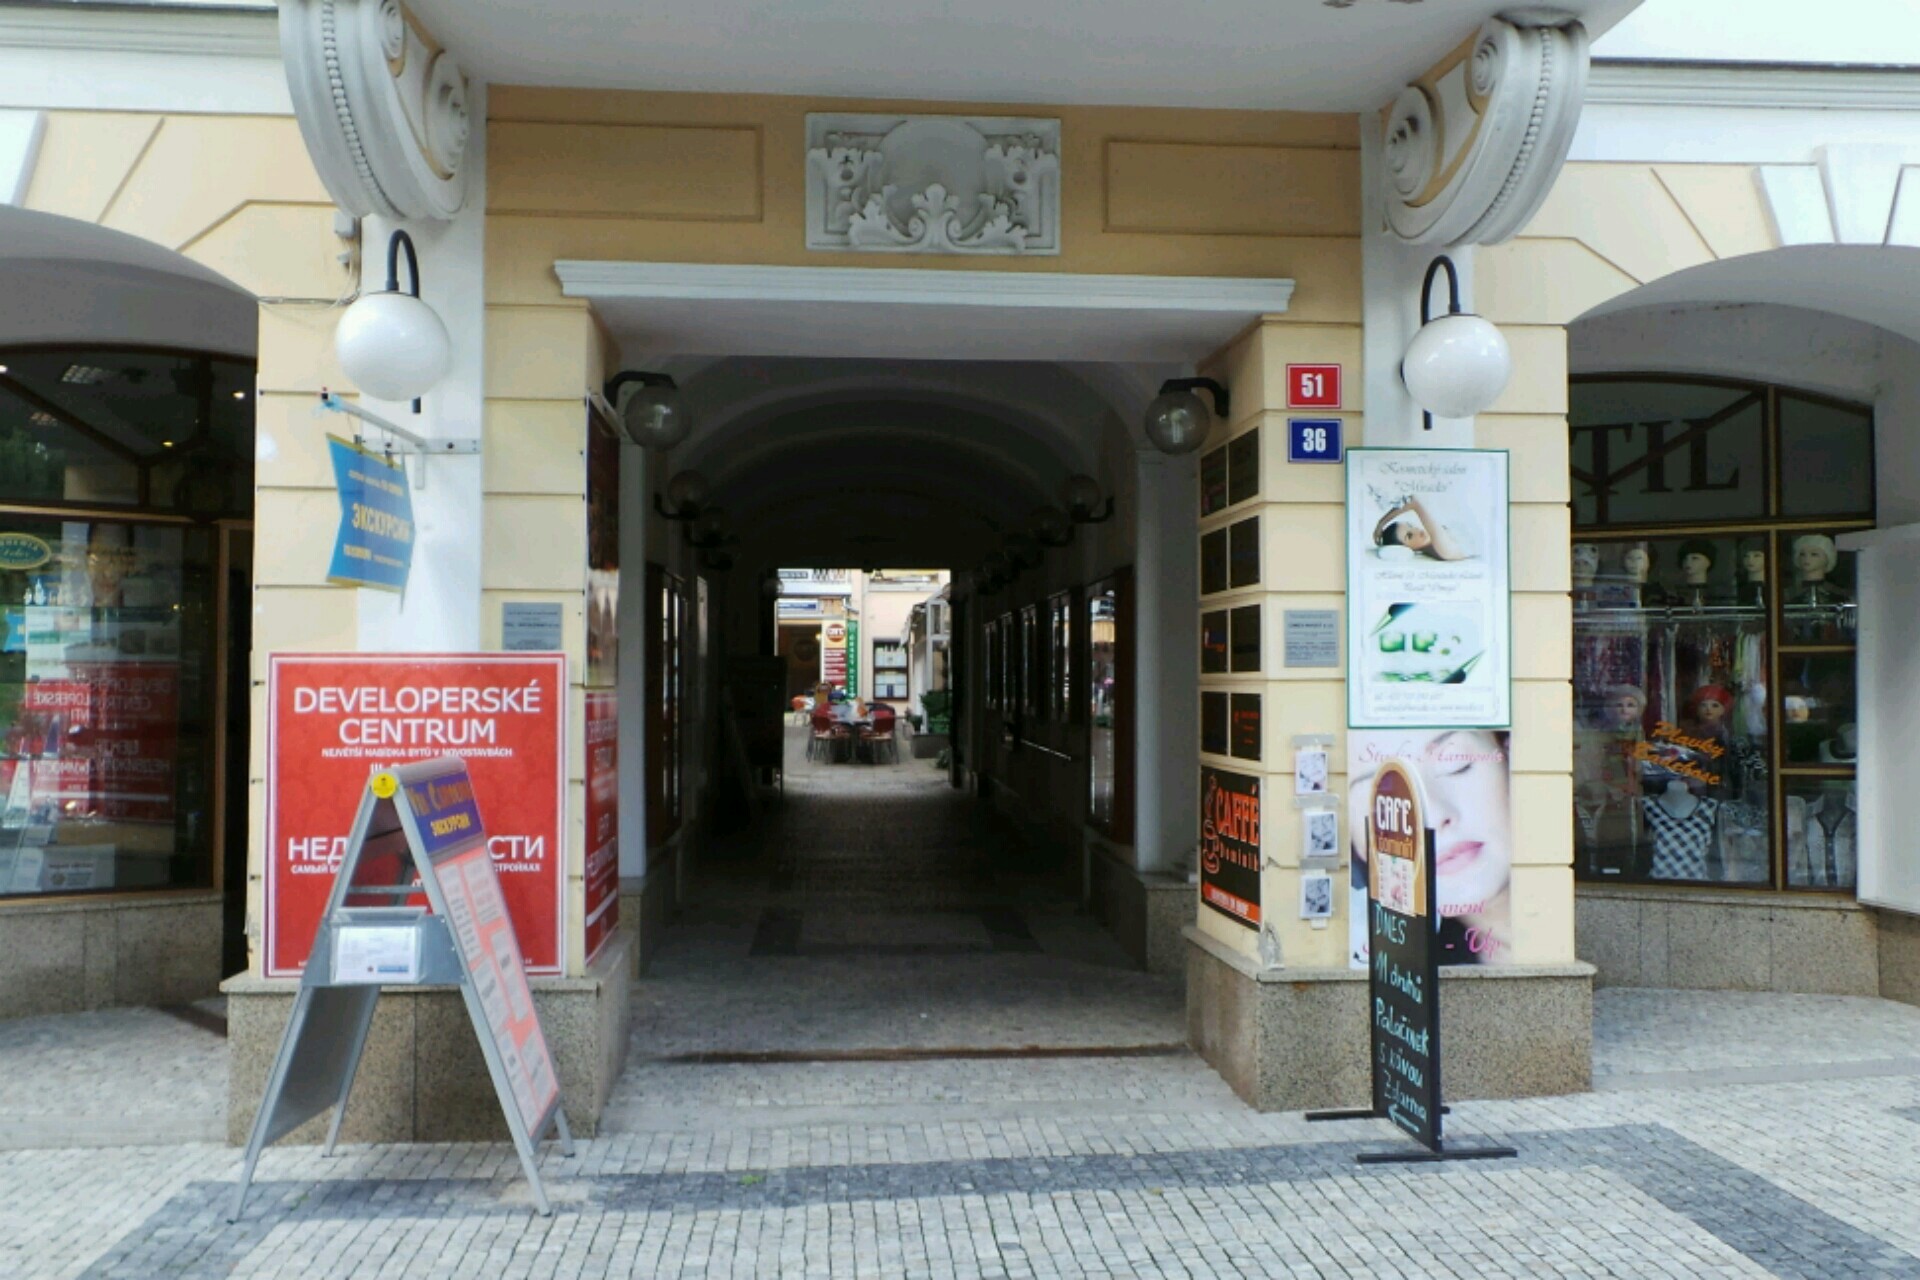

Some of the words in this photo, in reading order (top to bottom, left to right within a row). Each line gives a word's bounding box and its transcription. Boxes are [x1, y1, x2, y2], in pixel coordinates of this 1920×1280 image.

[1301, 373, 1323, 398] 51
[1302, 427, 1326, 453] 36
[293, 679, 542, 713] DEVELOPERSKÉ
[339, 718, 496, 745] CENTRUM
[1216, 784, 1260, 846] CAFFÉ
[1375, 903, 1407, 945] DNES
